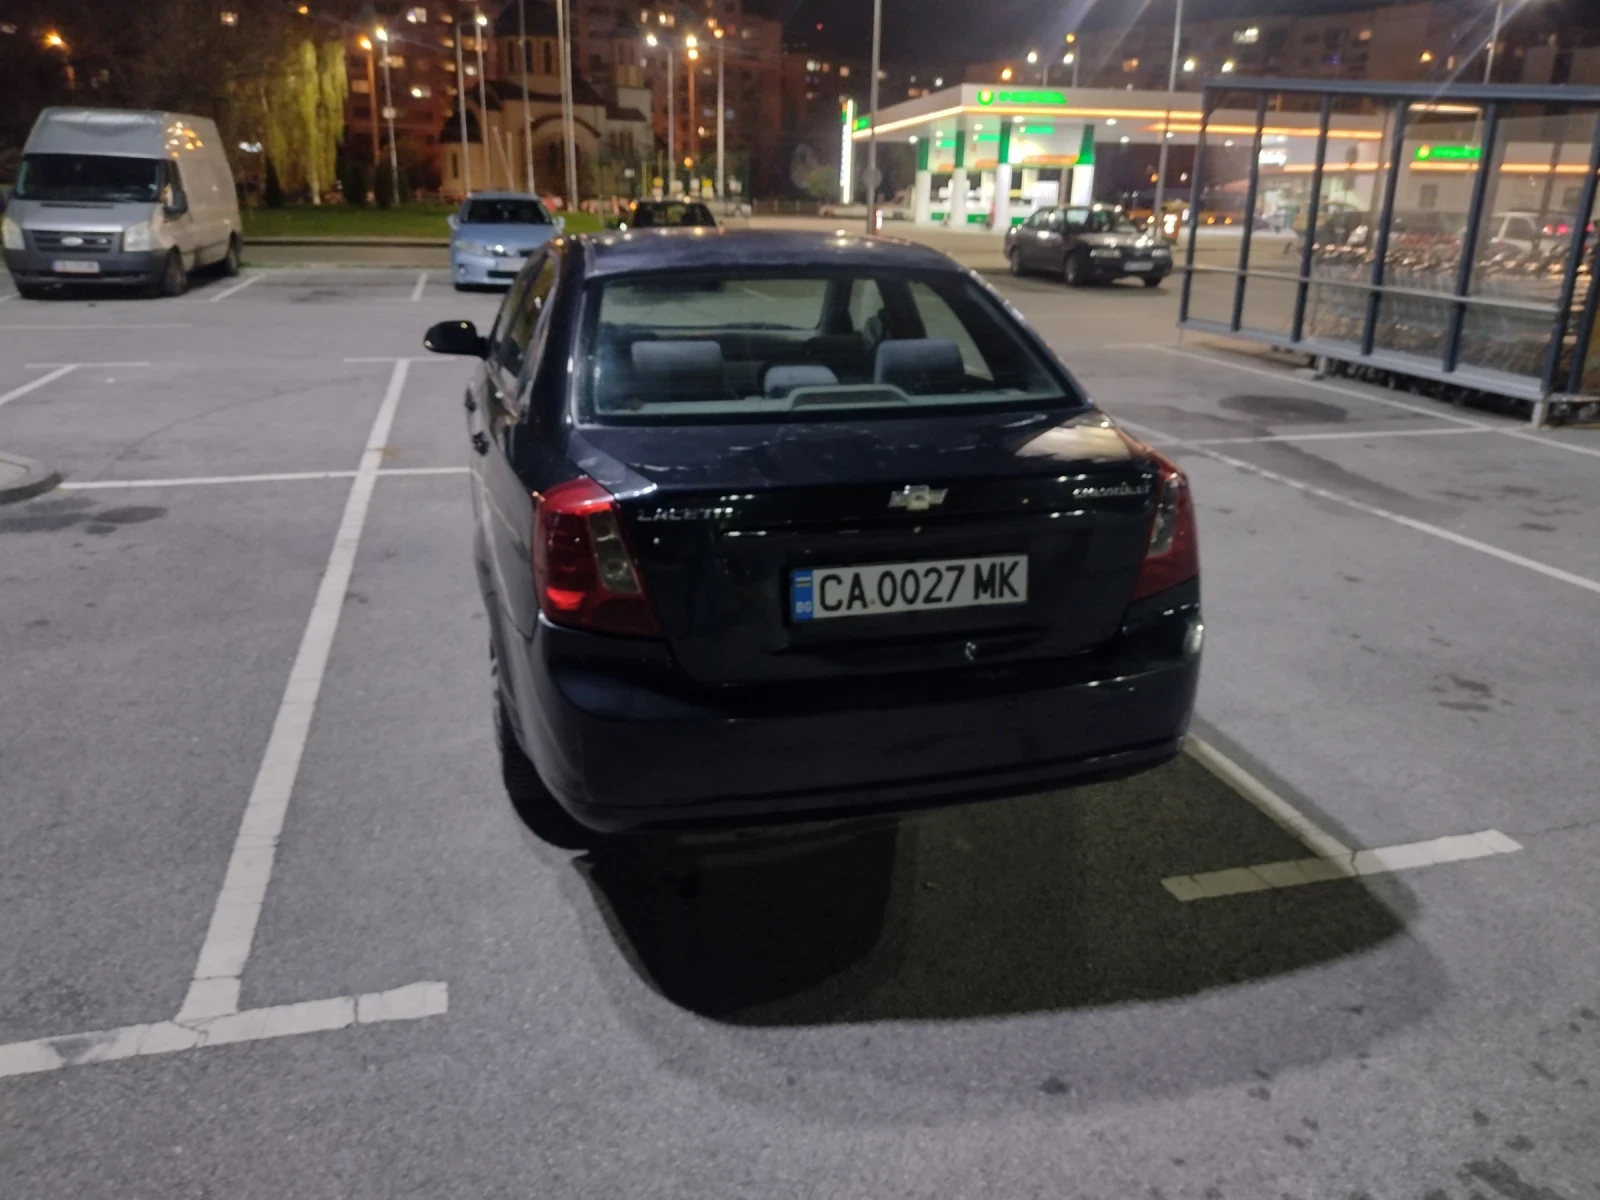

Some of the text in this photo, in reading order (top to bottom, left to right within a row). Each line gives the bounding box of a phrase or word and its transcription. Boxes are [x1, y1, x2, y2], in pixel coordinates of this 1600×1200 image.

[819, 560, 1020, 612] CA 0027 MK
[795, 600, 813, 613] BG
